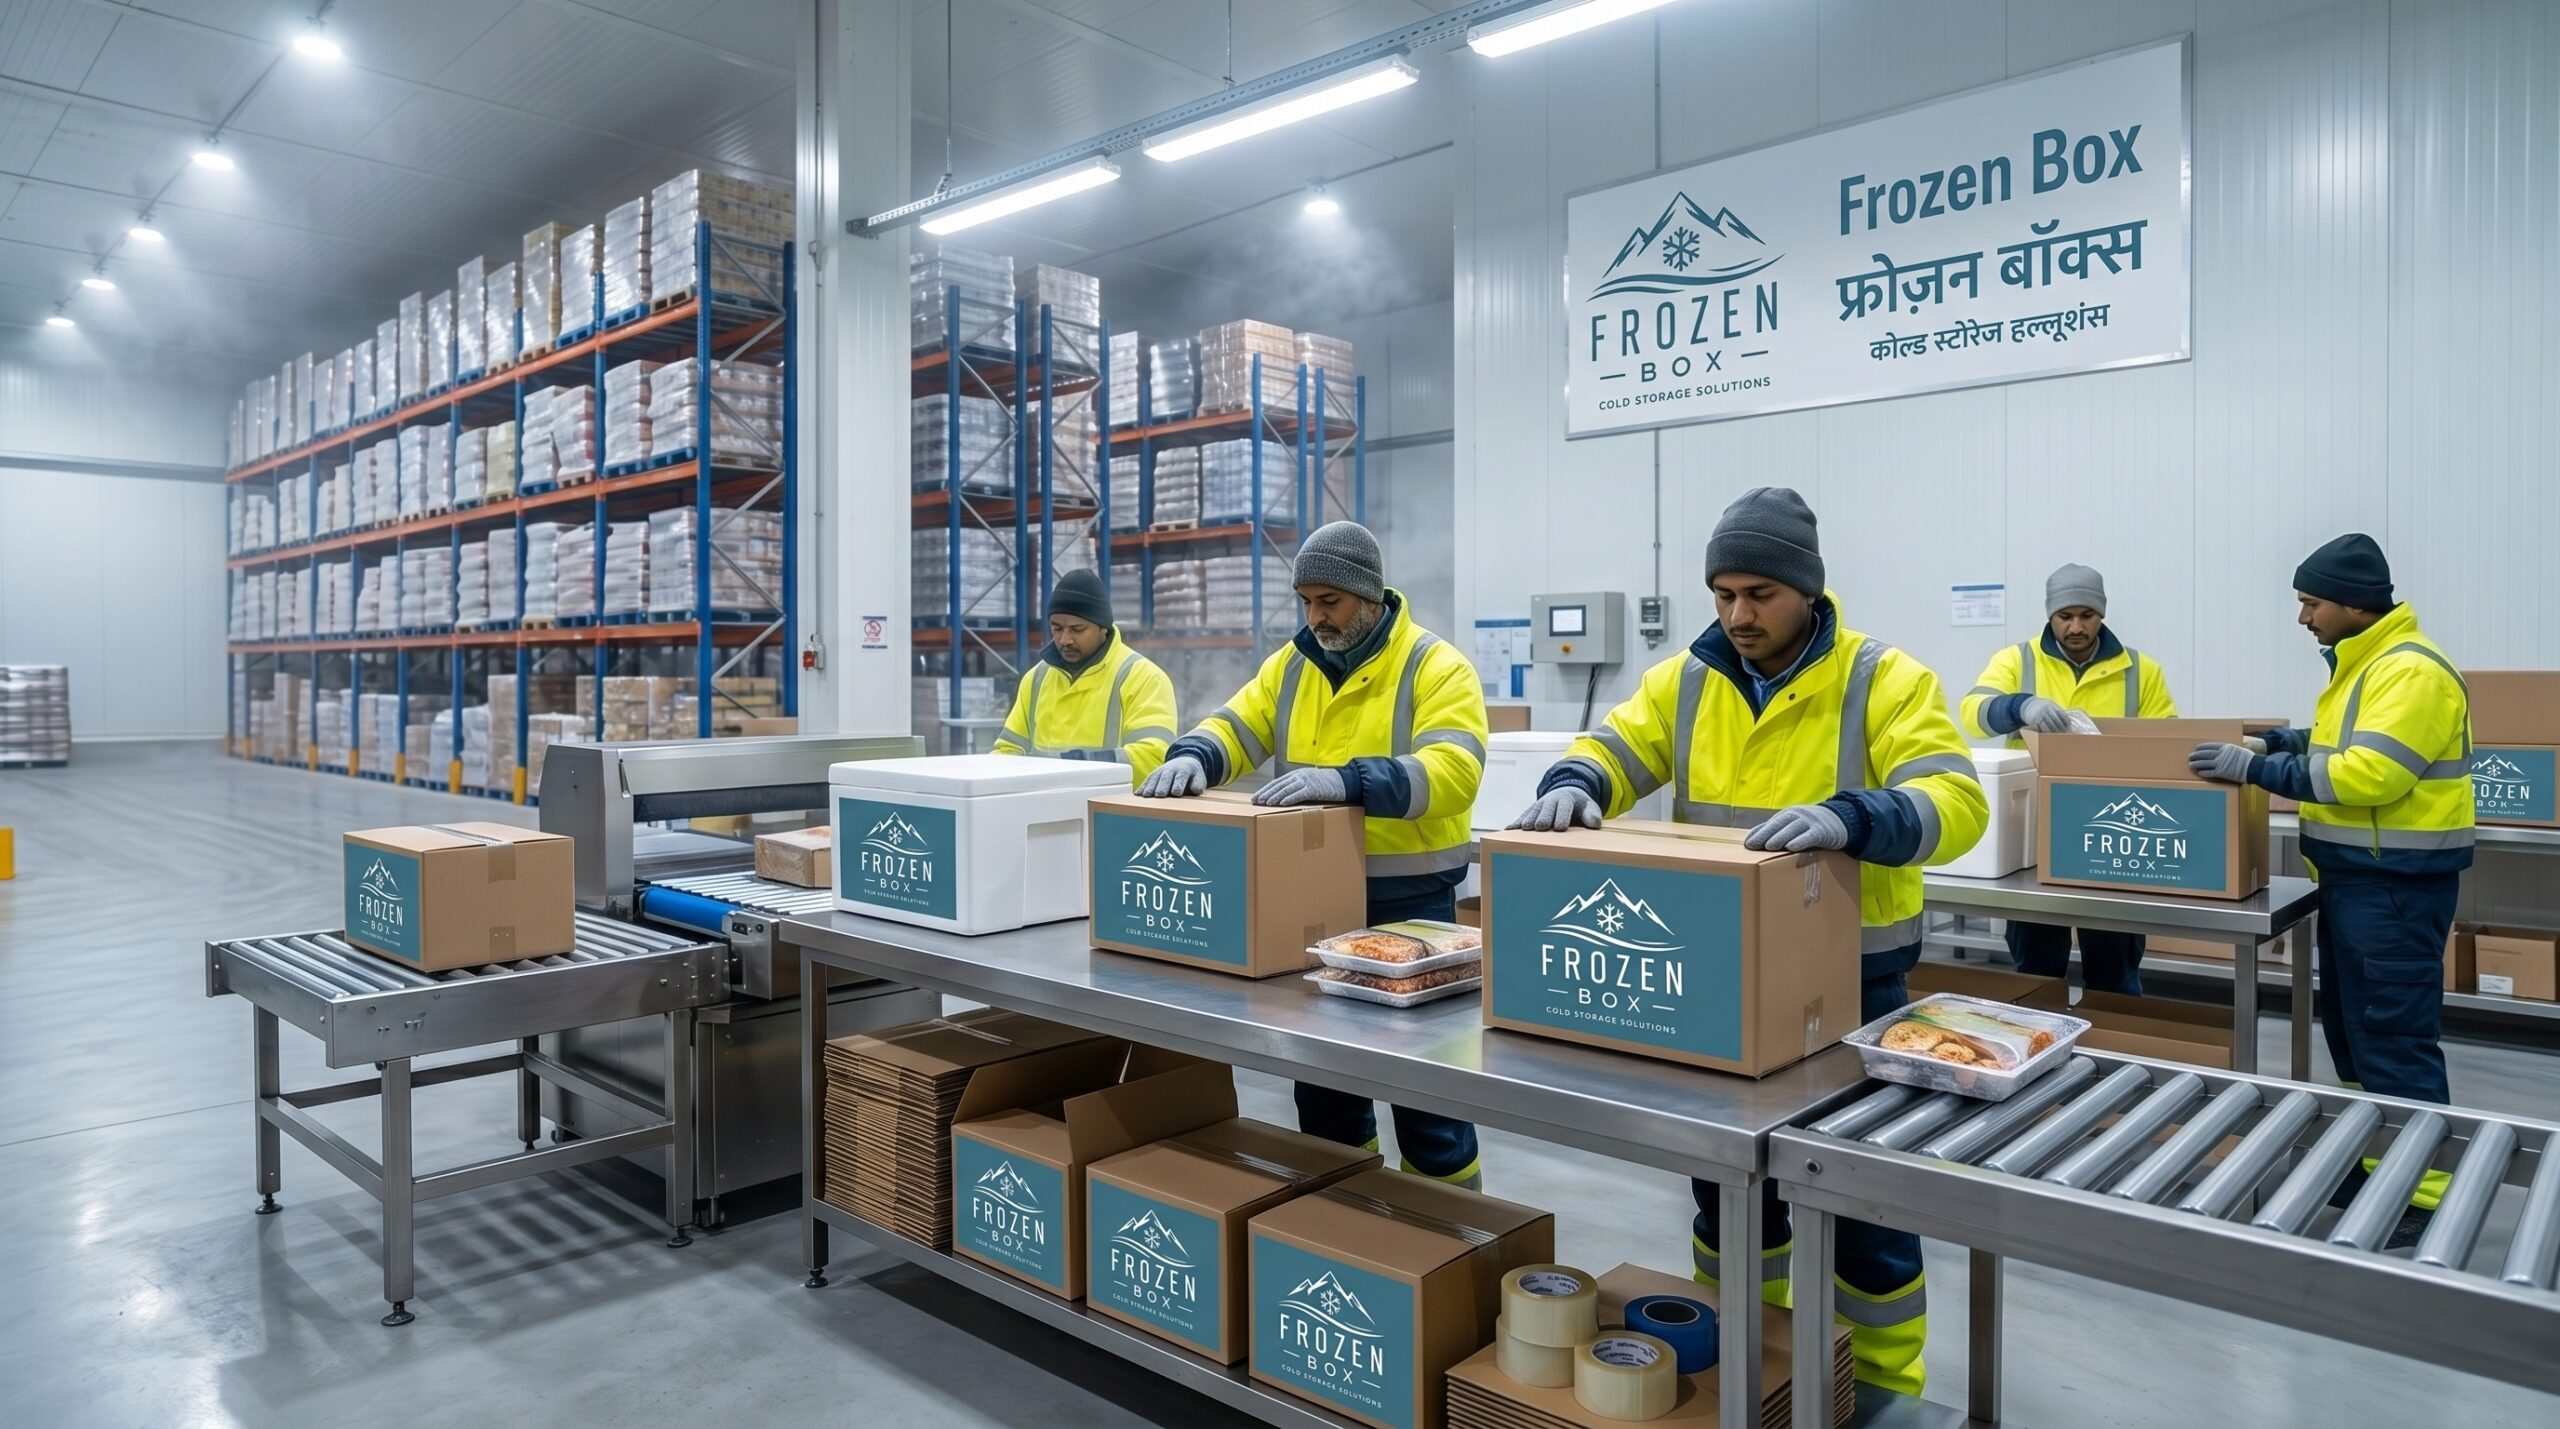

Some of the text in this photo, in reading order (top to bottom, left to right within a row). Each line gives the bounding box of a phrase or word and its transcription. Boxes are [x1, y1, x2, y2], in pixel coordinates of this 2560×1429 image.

[1840, 124, 2143, 236] Frozen Box
[1836, 219, 2148, 322] फ्रोज़न बॉक्स
[1592, 281, 1777, 361] FROZEN
[1870, 332, 1928, 361] कोल्ड
[1933, 319, 2004, 352] स्टोरेज
[1641, 350, 1722, 383] BOX
[1599, 376, 1771, 410] COLD STORAGE SOLUTIONS
[2472, 784, 2529, 800] OZEN
[2084, 833, 2186, 859] FROZEN
[861, 851, 932, 882] FROZEN
[2113, 858, 2155, 870] BOX
[880, 878, 910, 893] BOX
[1122, 880, 1212, 919] FROZEN
[360, 894, 403, 926] FROZEN
[1146, 914, 1185, 932] BOX
[371, 920, 390, 935] BOX
[1542, 944, 1683, 997] FROZEN
[1578, 988, 1641, 1013] BOX
[1546, 1006, 1677, 1035] COLD STORAGE SOLUTIONS
[973, 1197, 1044, 1245] FROZEN
[992, 1230, 1024, 1253] BOX
[1111, 1248, 1195, 1302] FROZEN
[1133, 1284, 1171, 1310] BOX
[1280, 1313, 1383, 1376] FROZEN
[1307, 1355, 1353, 1385] BOX
